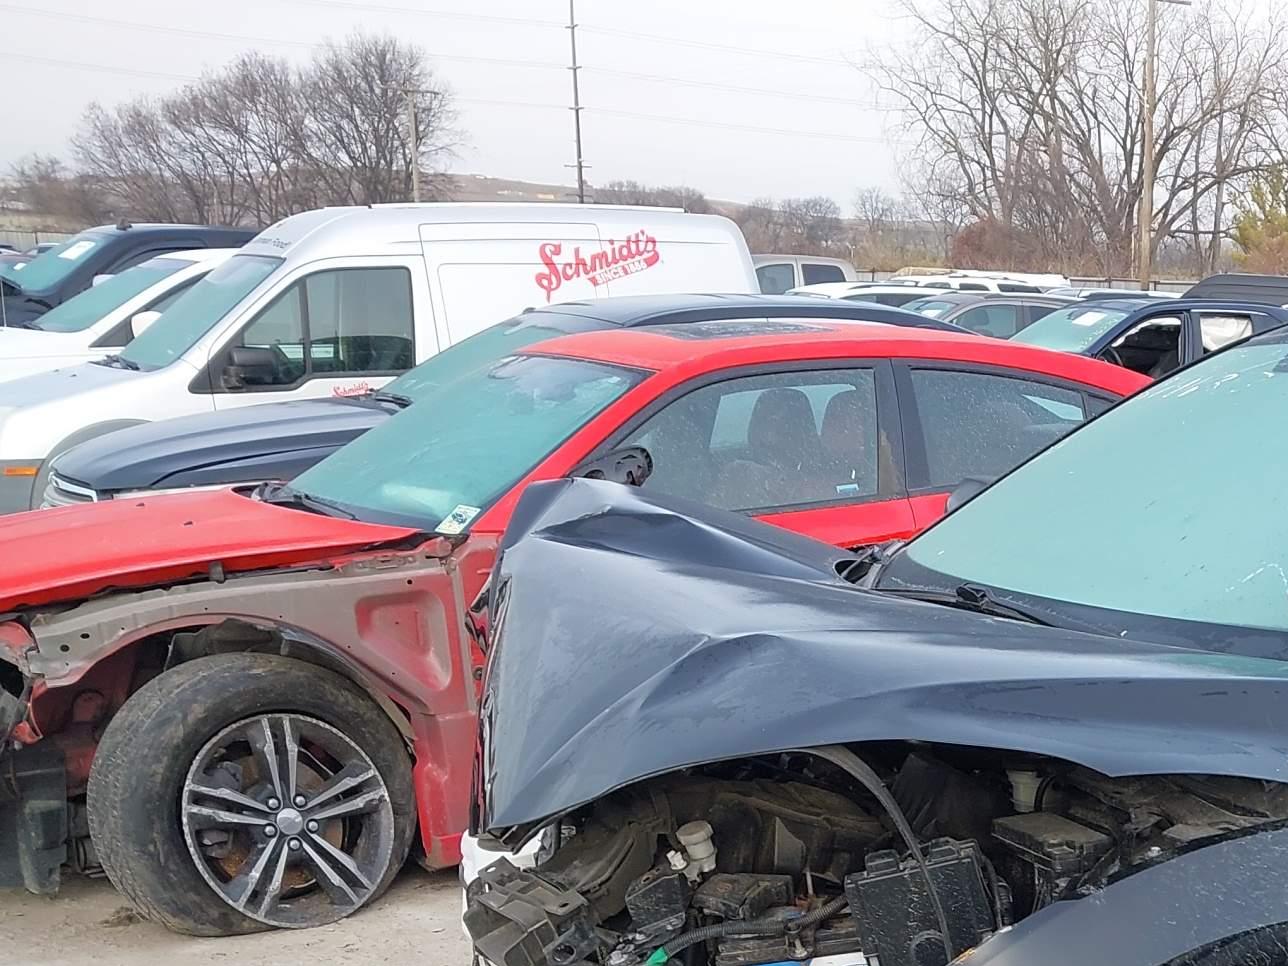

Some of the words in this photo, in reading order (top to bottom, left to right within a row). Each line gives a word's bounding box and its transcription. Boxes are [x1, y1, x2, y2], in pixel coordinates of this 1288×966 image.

[535, 229, 659, 303] Schmidt's
[595, 265, 626, 284] SINCE
[626, 259, 648, 276] 1886
